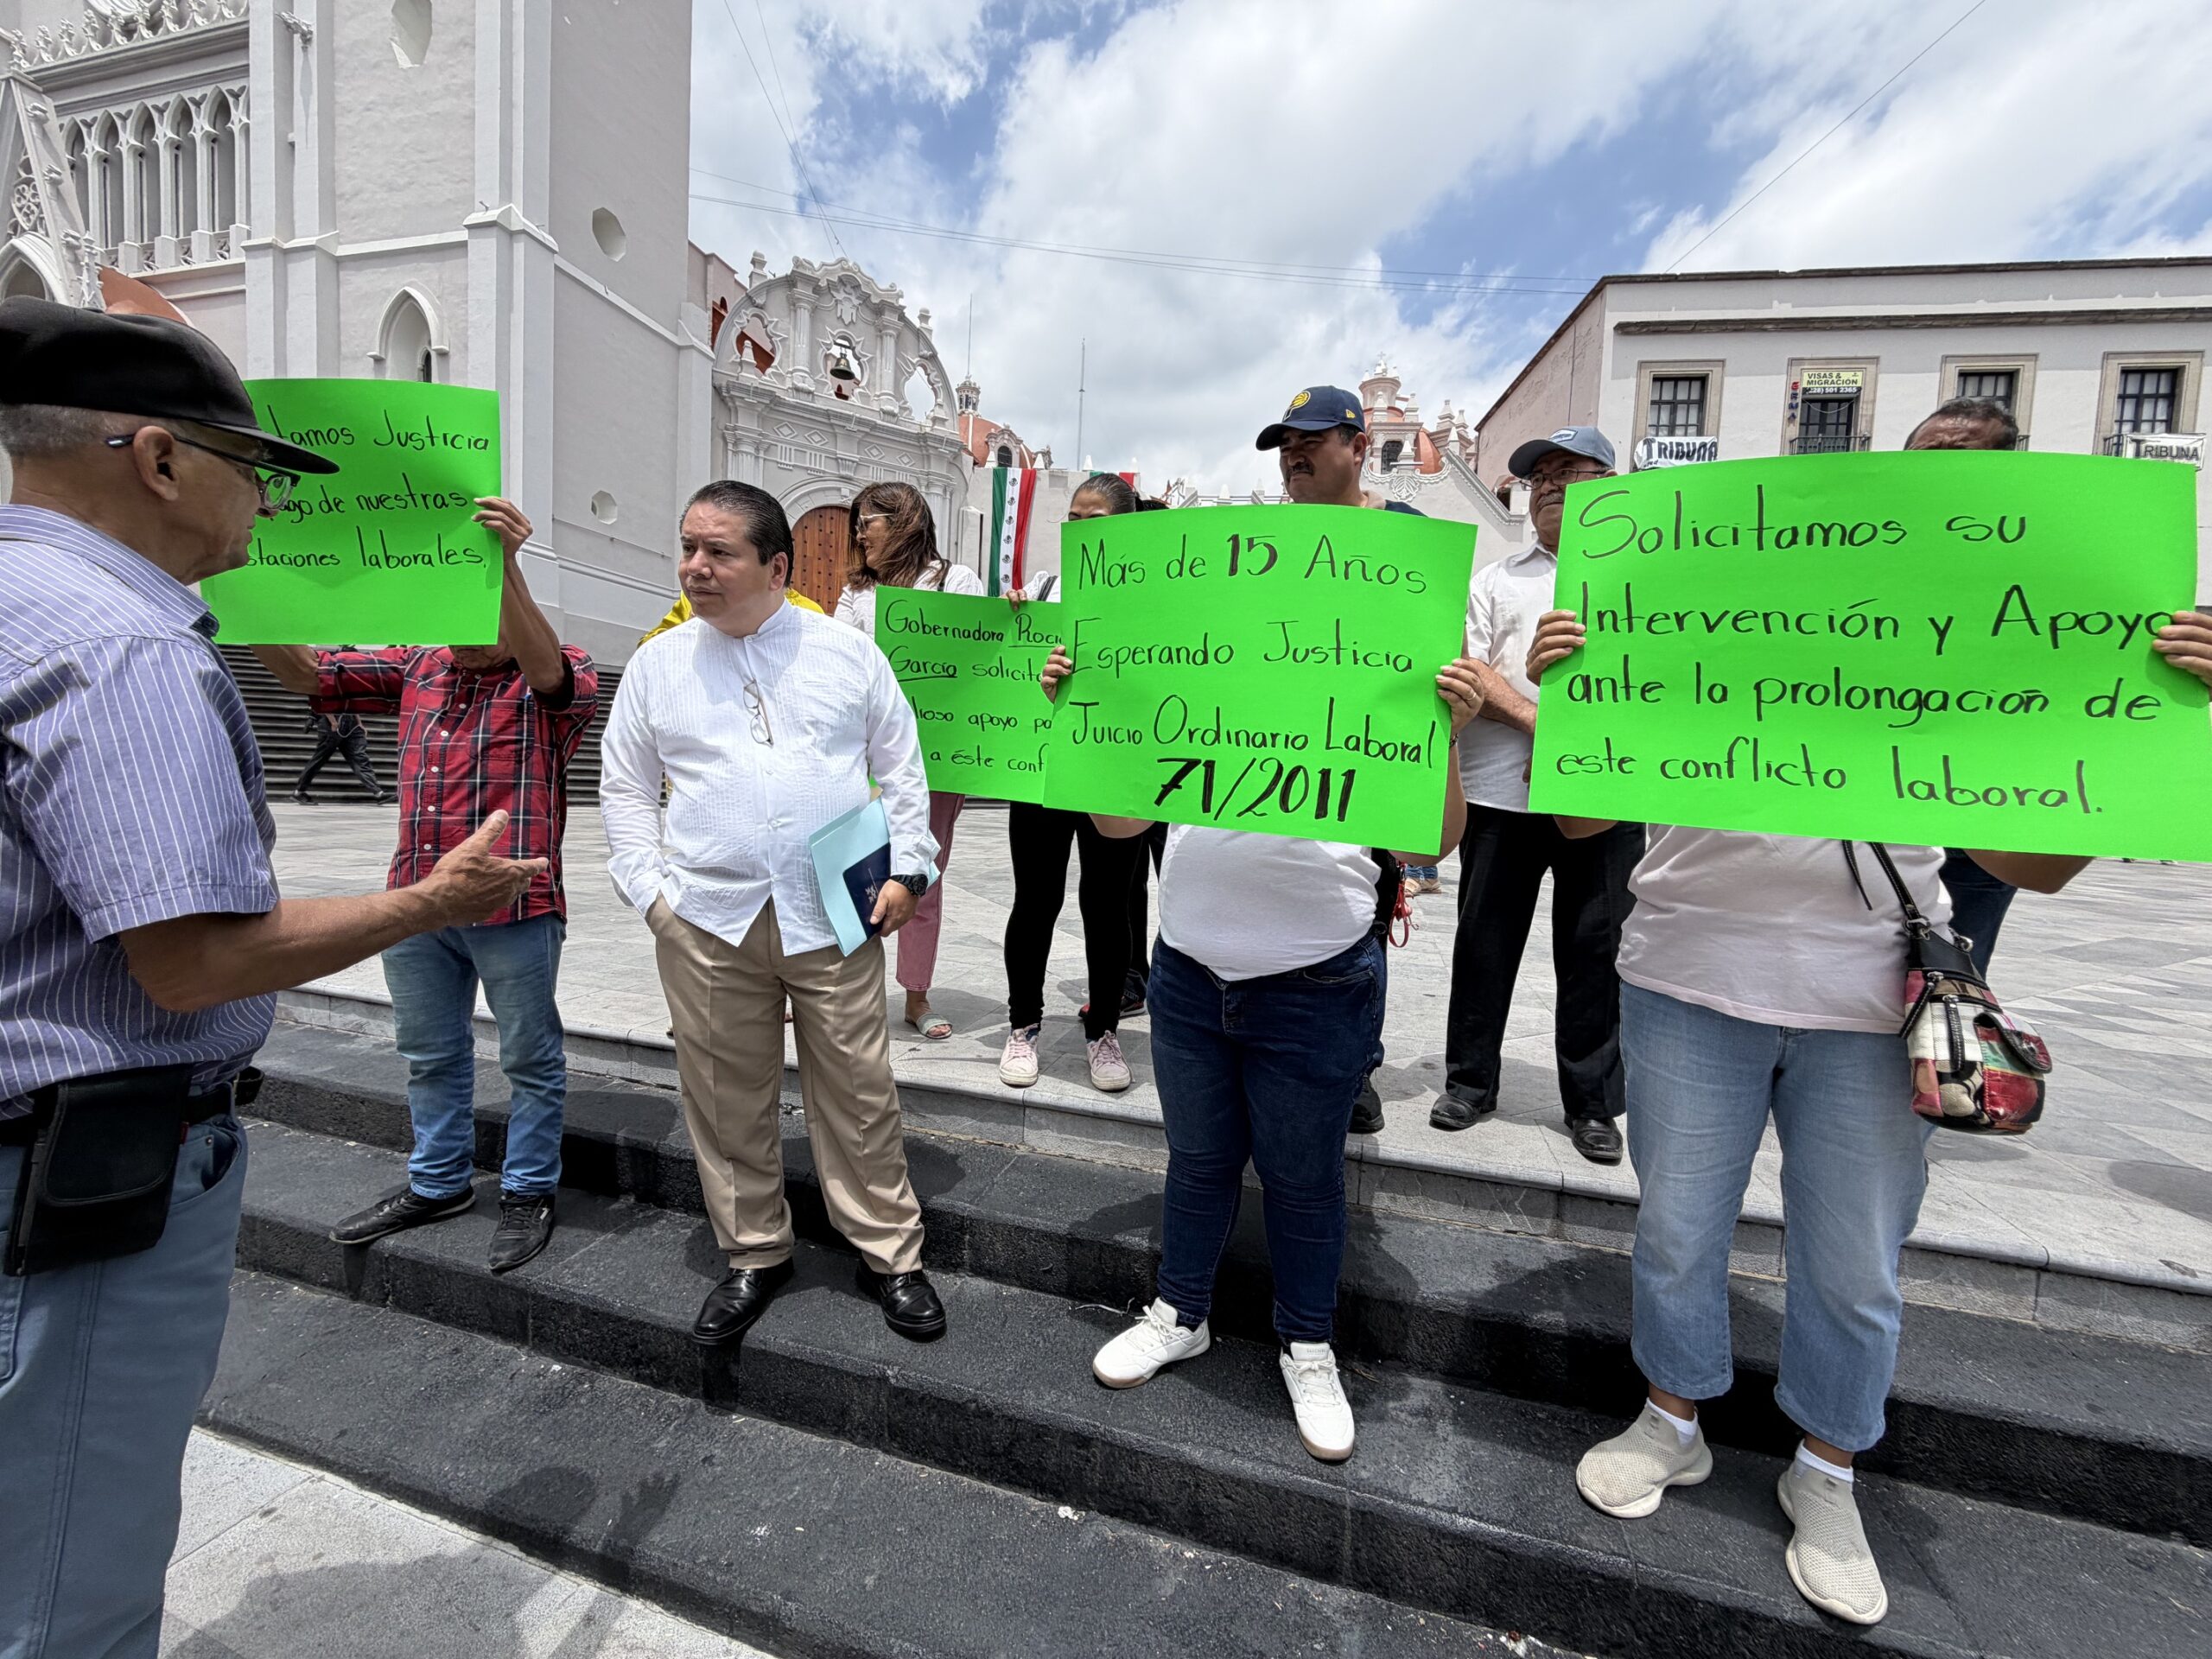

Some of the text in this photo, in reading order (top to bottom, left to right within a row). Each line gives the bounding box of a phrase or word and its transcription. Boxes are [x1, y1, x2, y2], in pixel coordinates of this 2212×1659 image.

[267, 404, 488, 450] tamos Justicia
[1643, 437, 1718, 461] TRIBUNA
[2131, 438, 2200, 461] TRIBUNA
[271, 473, 467, 524] ago de nuestras
[1580, 485, 2025, 558] Solicitamos su
[247, 524, 486, 569] staciones laborales.
[1079, 534, 1426, 593] Más de 15 Años
[886, 600, 1003, 642] Gobernadora
[1581, 581, 2175, 655] Intervención y Apoyo
[1071, 617, 1412, 679] Esperando Justicia
[912, 696, 1052, 733] lioso apoyo pa
[1567, 654, 1666, 704] ante
[1696, 662, 1727, 704] la
[2085, 677, 2160, 720] de
[931, 752, 941, 760] a
[1007, 742, 1050, 772] conf
[1069, 695, 1437, 769] Juicio Ordinario Laboral
[1154, 757, 1357, 822] 71/2011
[1557, 736, 2101, 813] este conflicto laboral.
